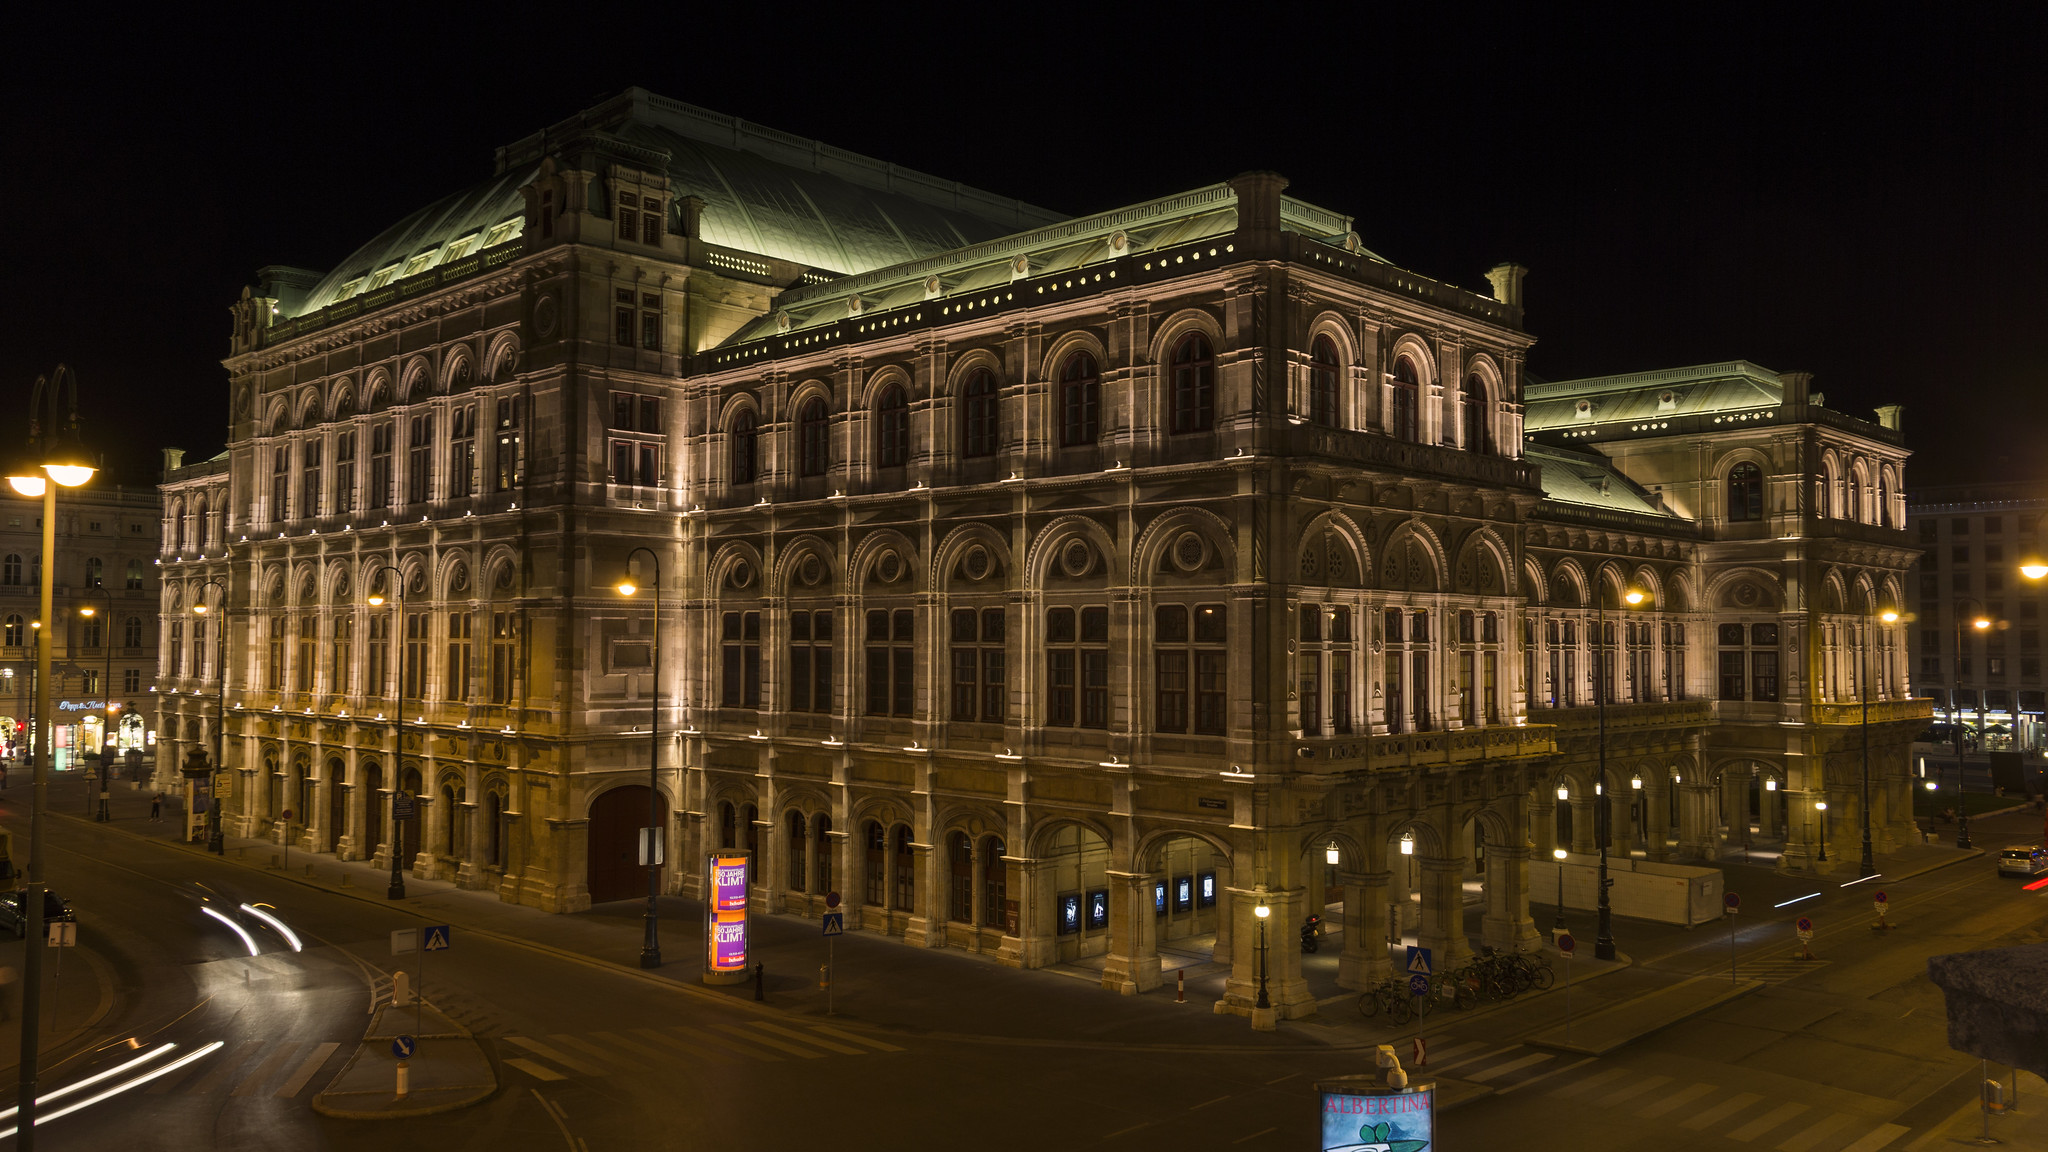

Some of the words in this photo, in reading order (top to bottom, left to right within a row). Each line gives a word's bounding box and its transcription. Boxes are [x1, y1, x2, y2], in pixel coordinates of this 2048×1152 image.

[726, 869, 744, 878] JAHRE
[715, 876, 744, 886] KLIMT
[725, 926, 743, 934] JAHRE
[714, 932, 743, 943] KLIMT
[1324, 1093, 1430, 1115] ALBERTINA
